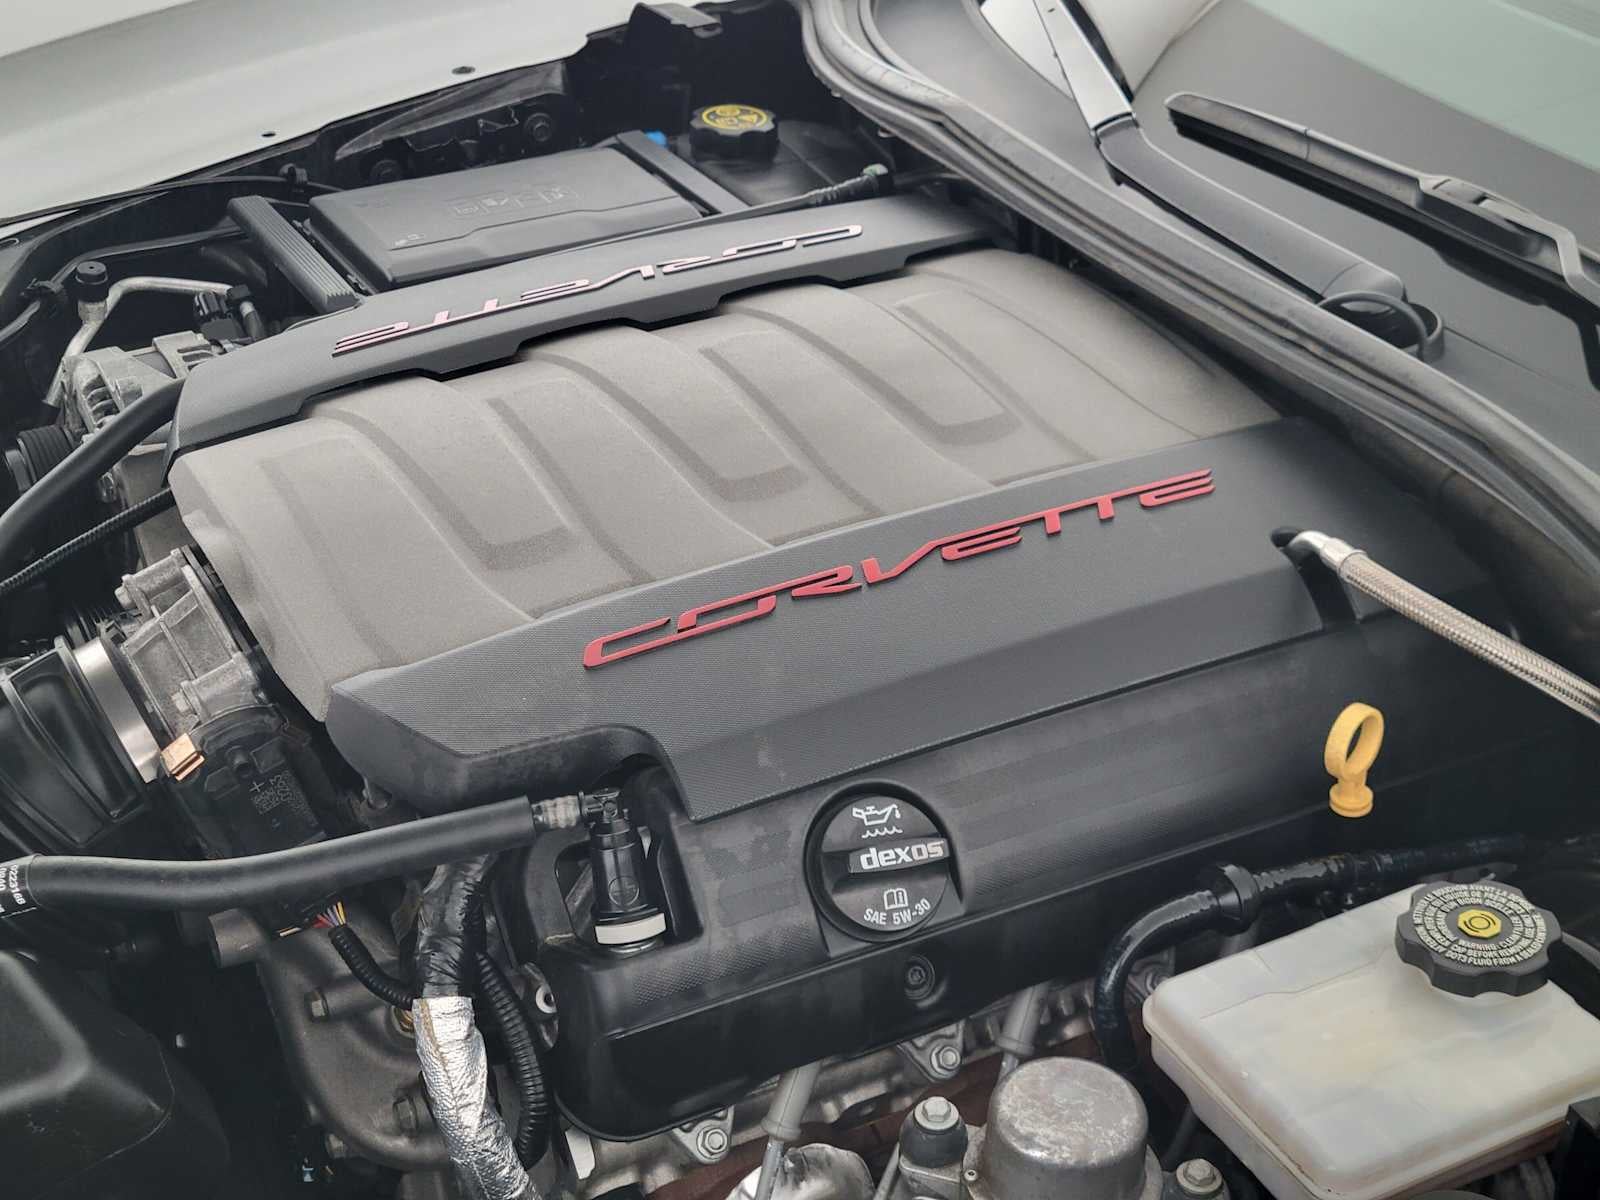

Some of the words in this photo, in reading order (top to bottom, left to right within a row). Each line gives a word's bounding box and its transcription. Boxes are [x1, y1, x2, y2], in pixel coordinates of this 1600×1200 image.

[332, 224, 863, 357] CORVETTE
[583, 468, 1216, 669] CORVETTE
[860, 840, 945, 870] dexos
[863, 908, 888, 925] SAE
[893, 898, 931, 925] 5W-30
[1467, 956, 1493, 967] FLUID
